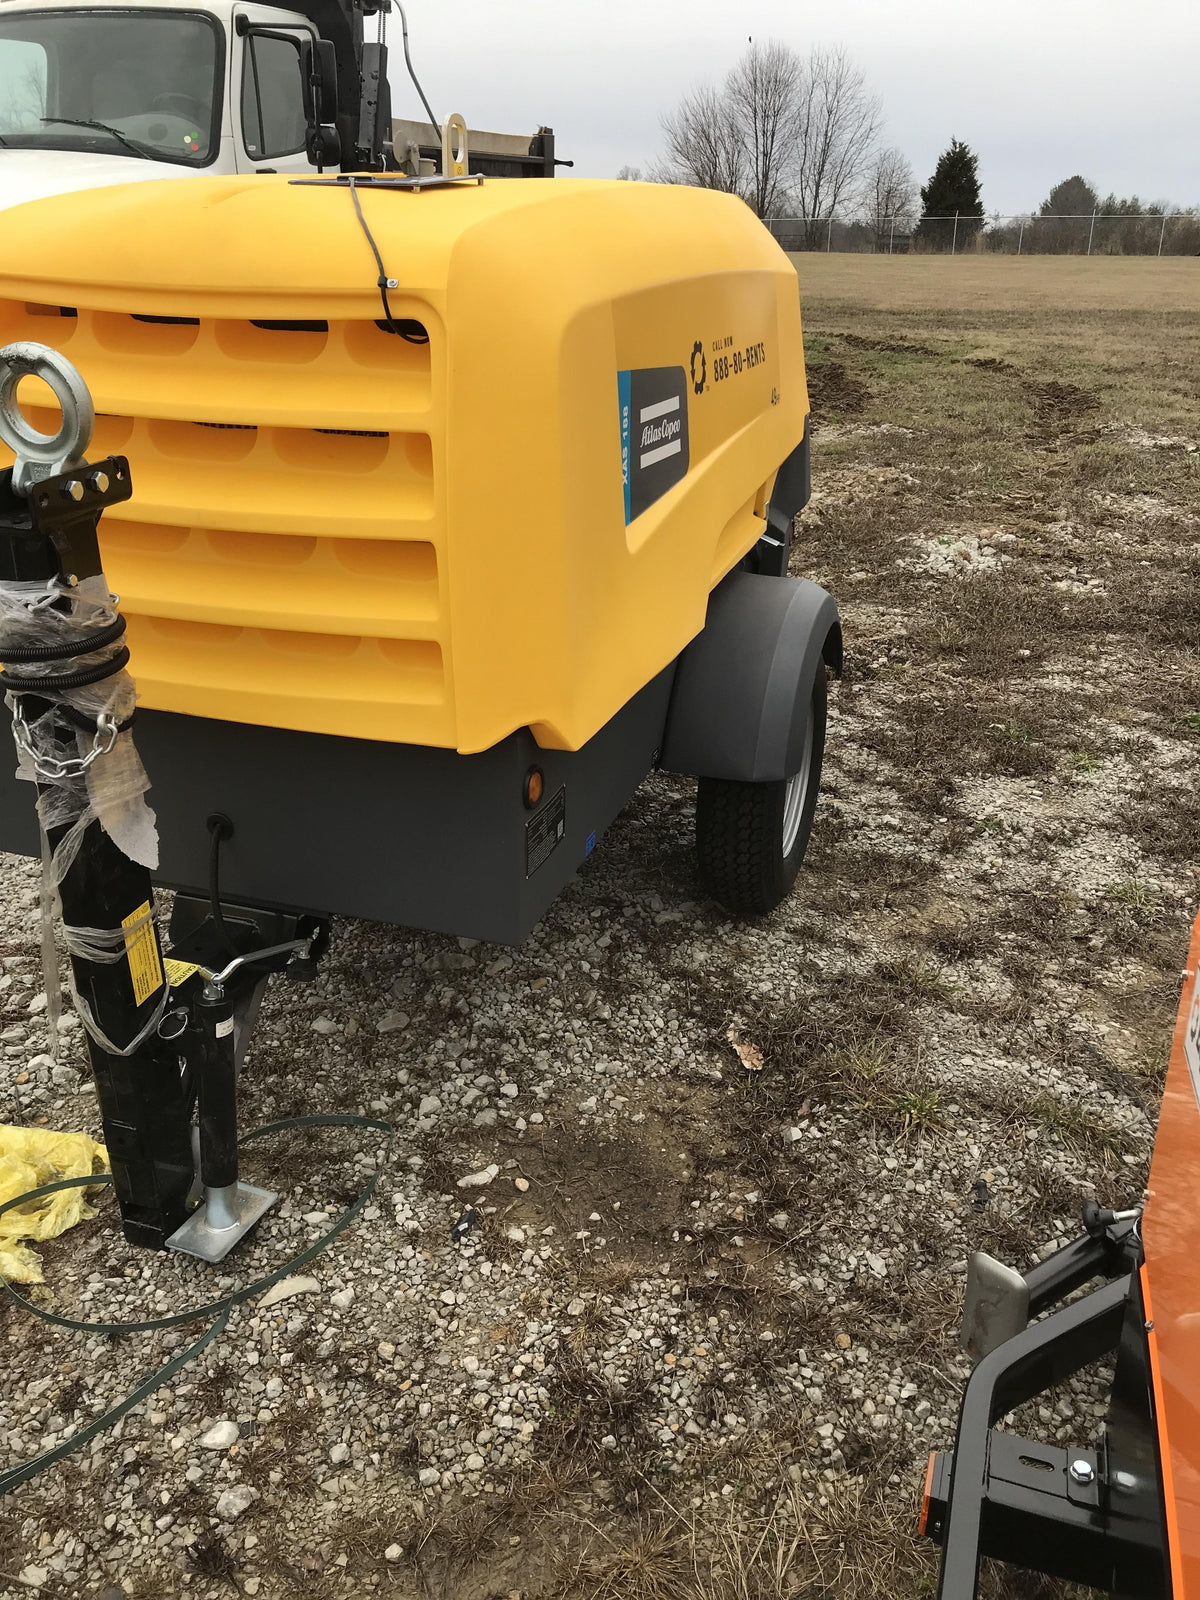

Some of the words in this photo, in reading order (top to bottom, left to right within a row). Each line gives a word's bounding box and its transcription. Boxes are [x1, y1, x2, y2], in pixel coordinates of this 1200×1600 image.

[712, 339, 723, 352] CALL
[724, 336, 733, 347] NOW
[713, 342, 766, 382] 888-80-RENTS
[640, 425, 662, 448] Atlas
[661, 419, 681, 440] Copco
[170, 966, 196, 985] CAUTION
